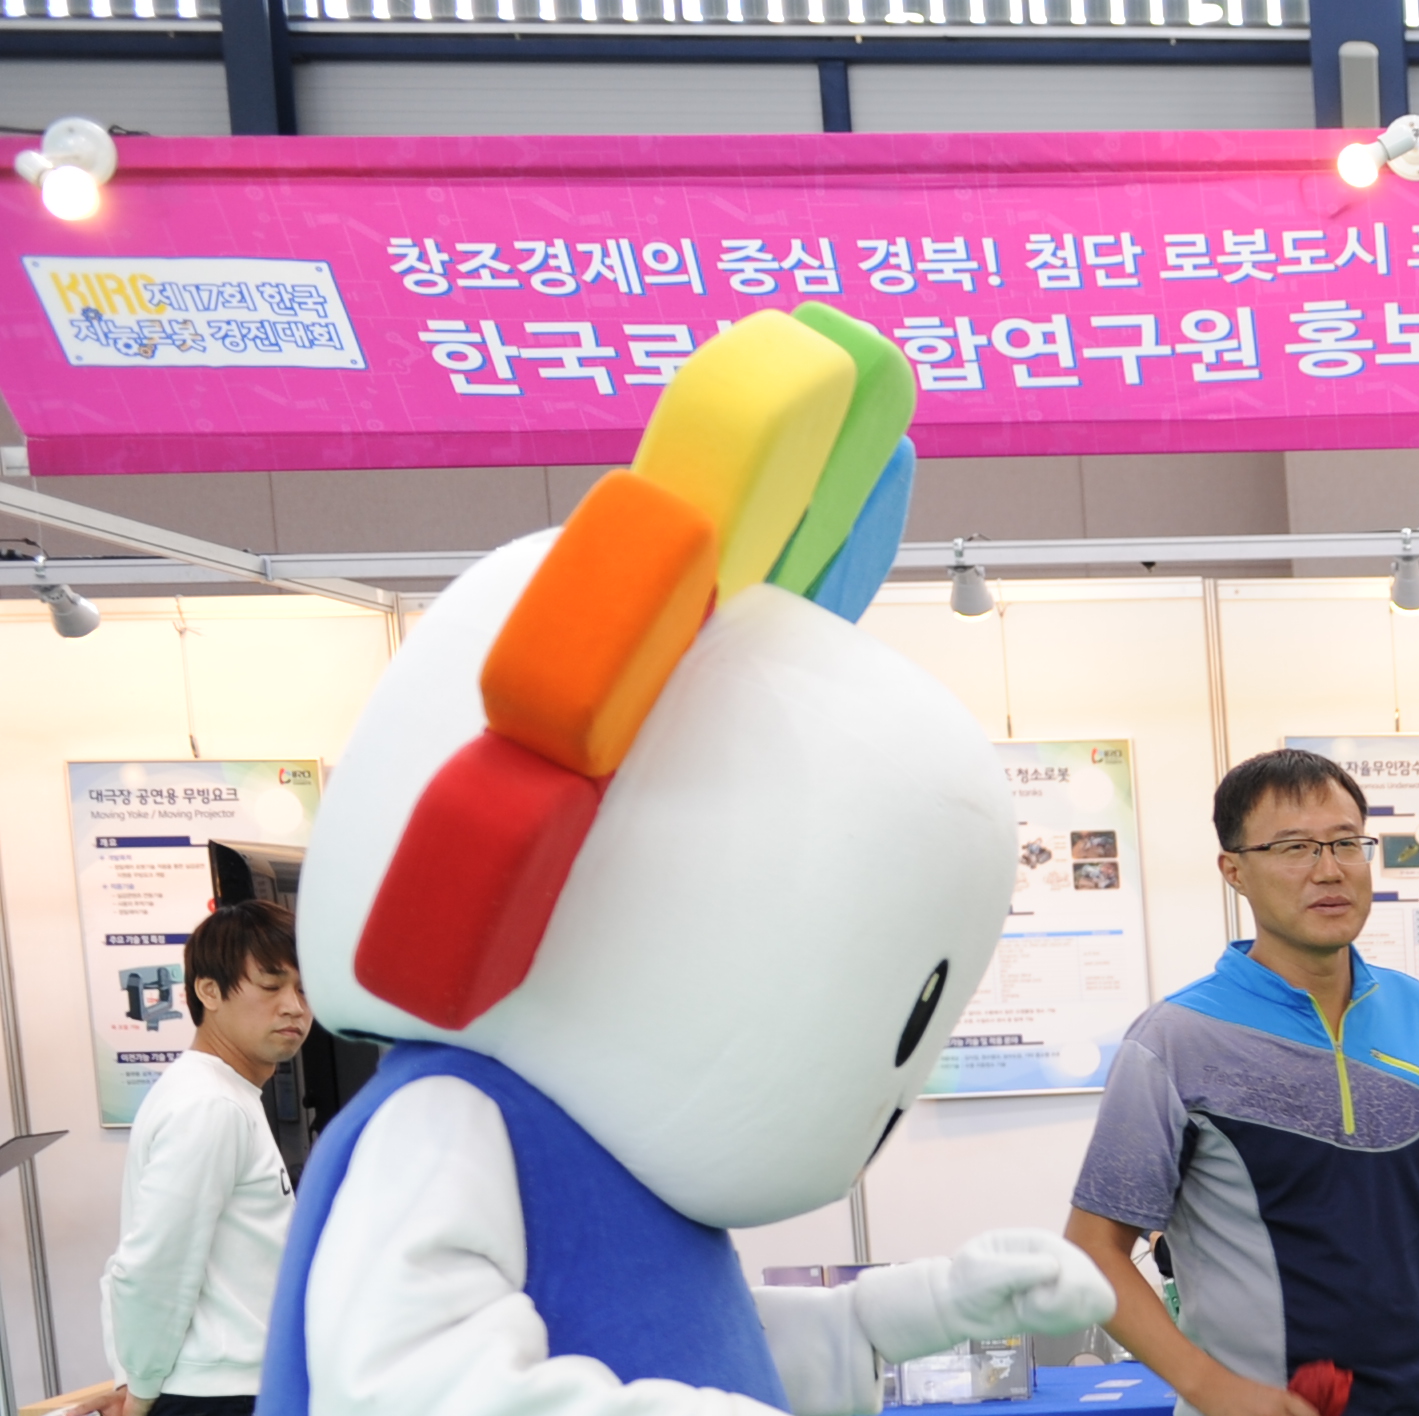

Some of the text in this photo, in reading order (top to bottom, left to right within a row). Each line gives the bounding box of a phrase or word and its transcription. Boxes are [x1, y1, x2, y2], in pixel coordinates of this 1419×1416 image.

[387, 238, 703, 296] 창조경제의
[716, 236, 839, 294] 중심
[856, 235, 1003, 295] 경북!
[1023, 231, 1143, 290] 첨단
[1159, 222, 1389, 286] 로봇도시
[256, 283, 329, 318] 한국
[70, 319, 345, 357] 지능로봇 경진대회
[418, 304, 1262, 396] 한국로합연구원
[1016, 767, 1070, 784] 청소로봇
[89, 787, 240, 805] 대극장 공연용 무빙요크
[91, 810, 125, 821] Moving
[127, 810, 150, 820] Yoke
[158, 809, 192, 820] Moving
[194, 809, 235, 820] Projector
